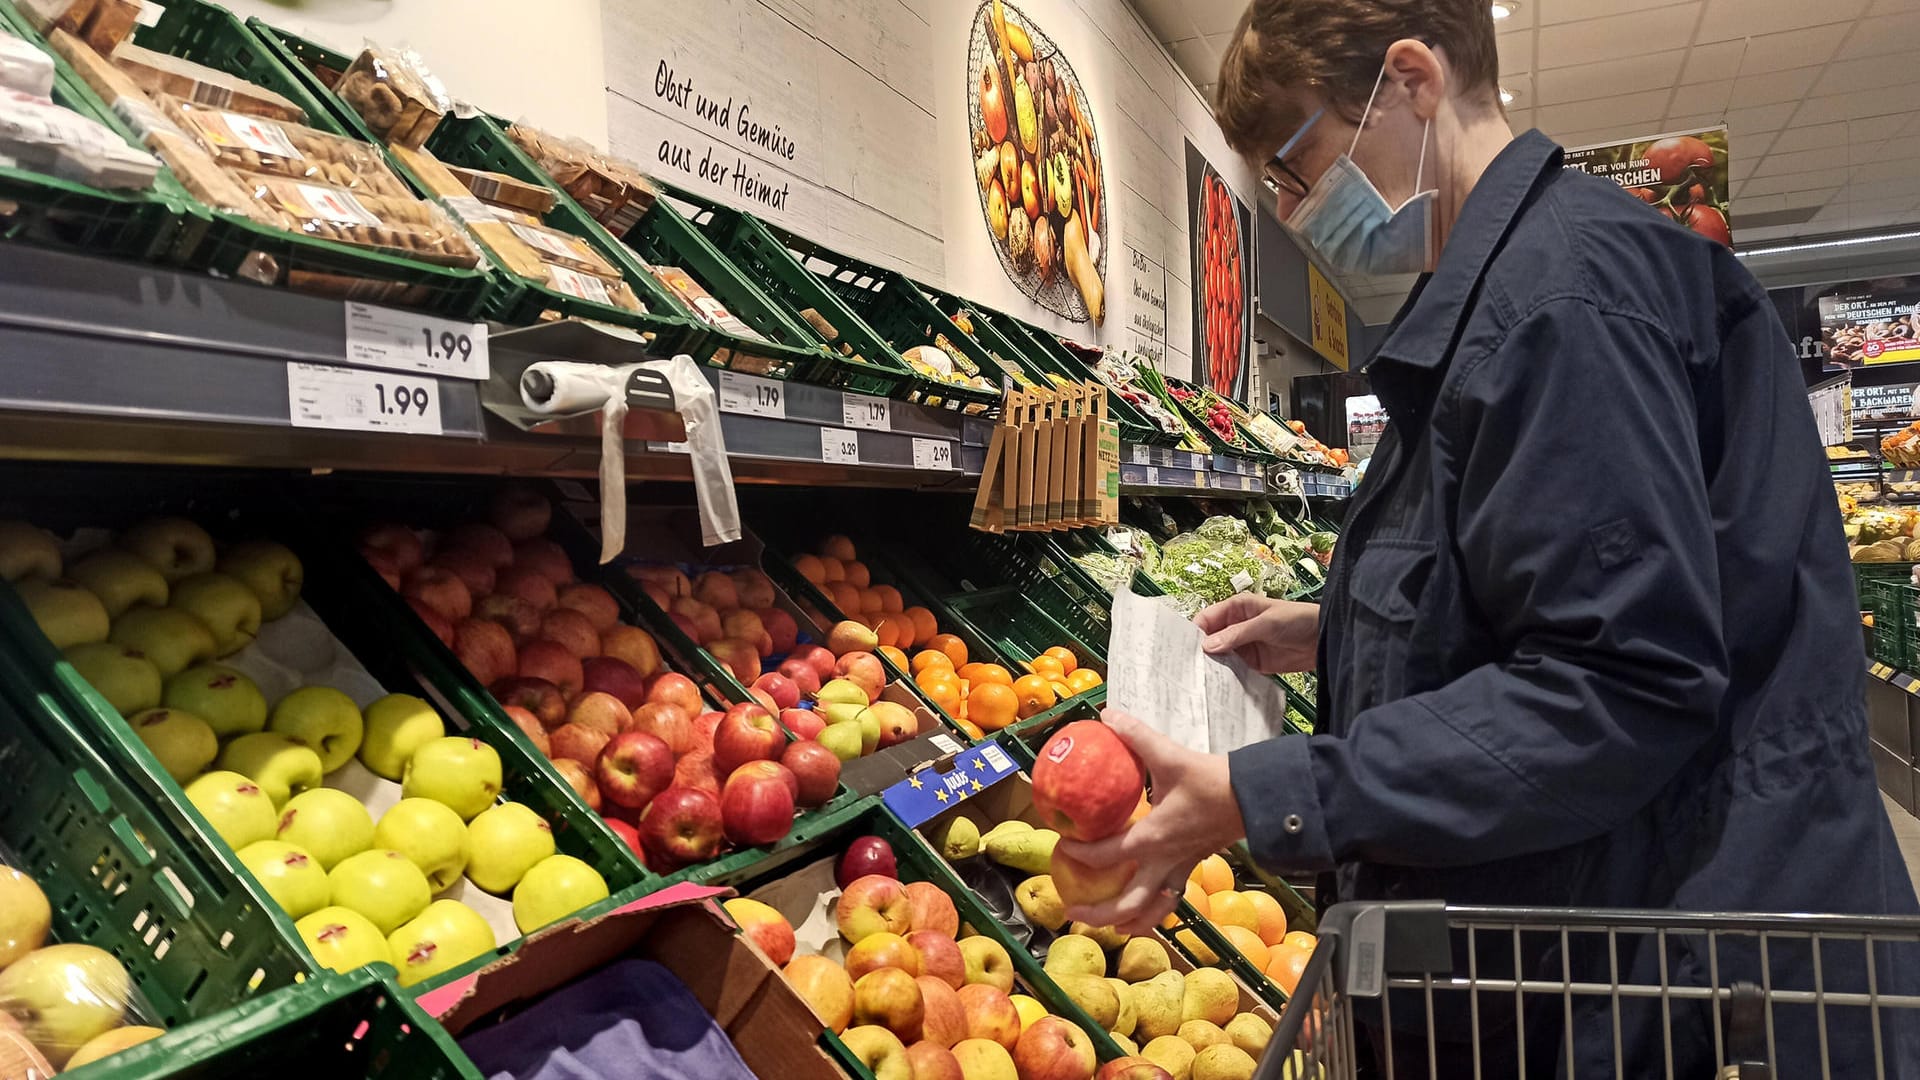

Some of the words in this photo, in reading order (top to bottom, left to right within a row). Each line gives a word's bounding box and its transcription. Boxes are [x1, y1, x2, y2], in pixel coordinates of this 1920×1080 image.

[655, 59, 692, 109] Obst
[696, 95, 732, 130] und
[737, 104, 795, 160] Gemüse
[1562, 162, 1590, 175] T.
[1592, 164, 1607, 174] DER
[1611, 162, 1627, 171] VON
[1630, 159, 1650, 169] RUND
[658, 140, 691, 173] aus
[699, 146, 728, 186] der
[732, 158, 789, 211] Heimat
[1834, 303, 1849, 312] DER
[1851, 301, 1869, 310] ORT.
[1847, 306, 1892, 319] DEUTSCHEN
[422, 327, 472, 362] 1.99
[755, 384, 779, 408] 1.79
[1866, 386, 1886, 396] ORT.
[375, 383, 429, 417] 1.99
[1860, 394, 1915, 407] BACKWAREN
[868, 402, 886, 422] 1.79
[841, 442, 856, 456] 3.29
[933, 446, 949, 462] 2.99
